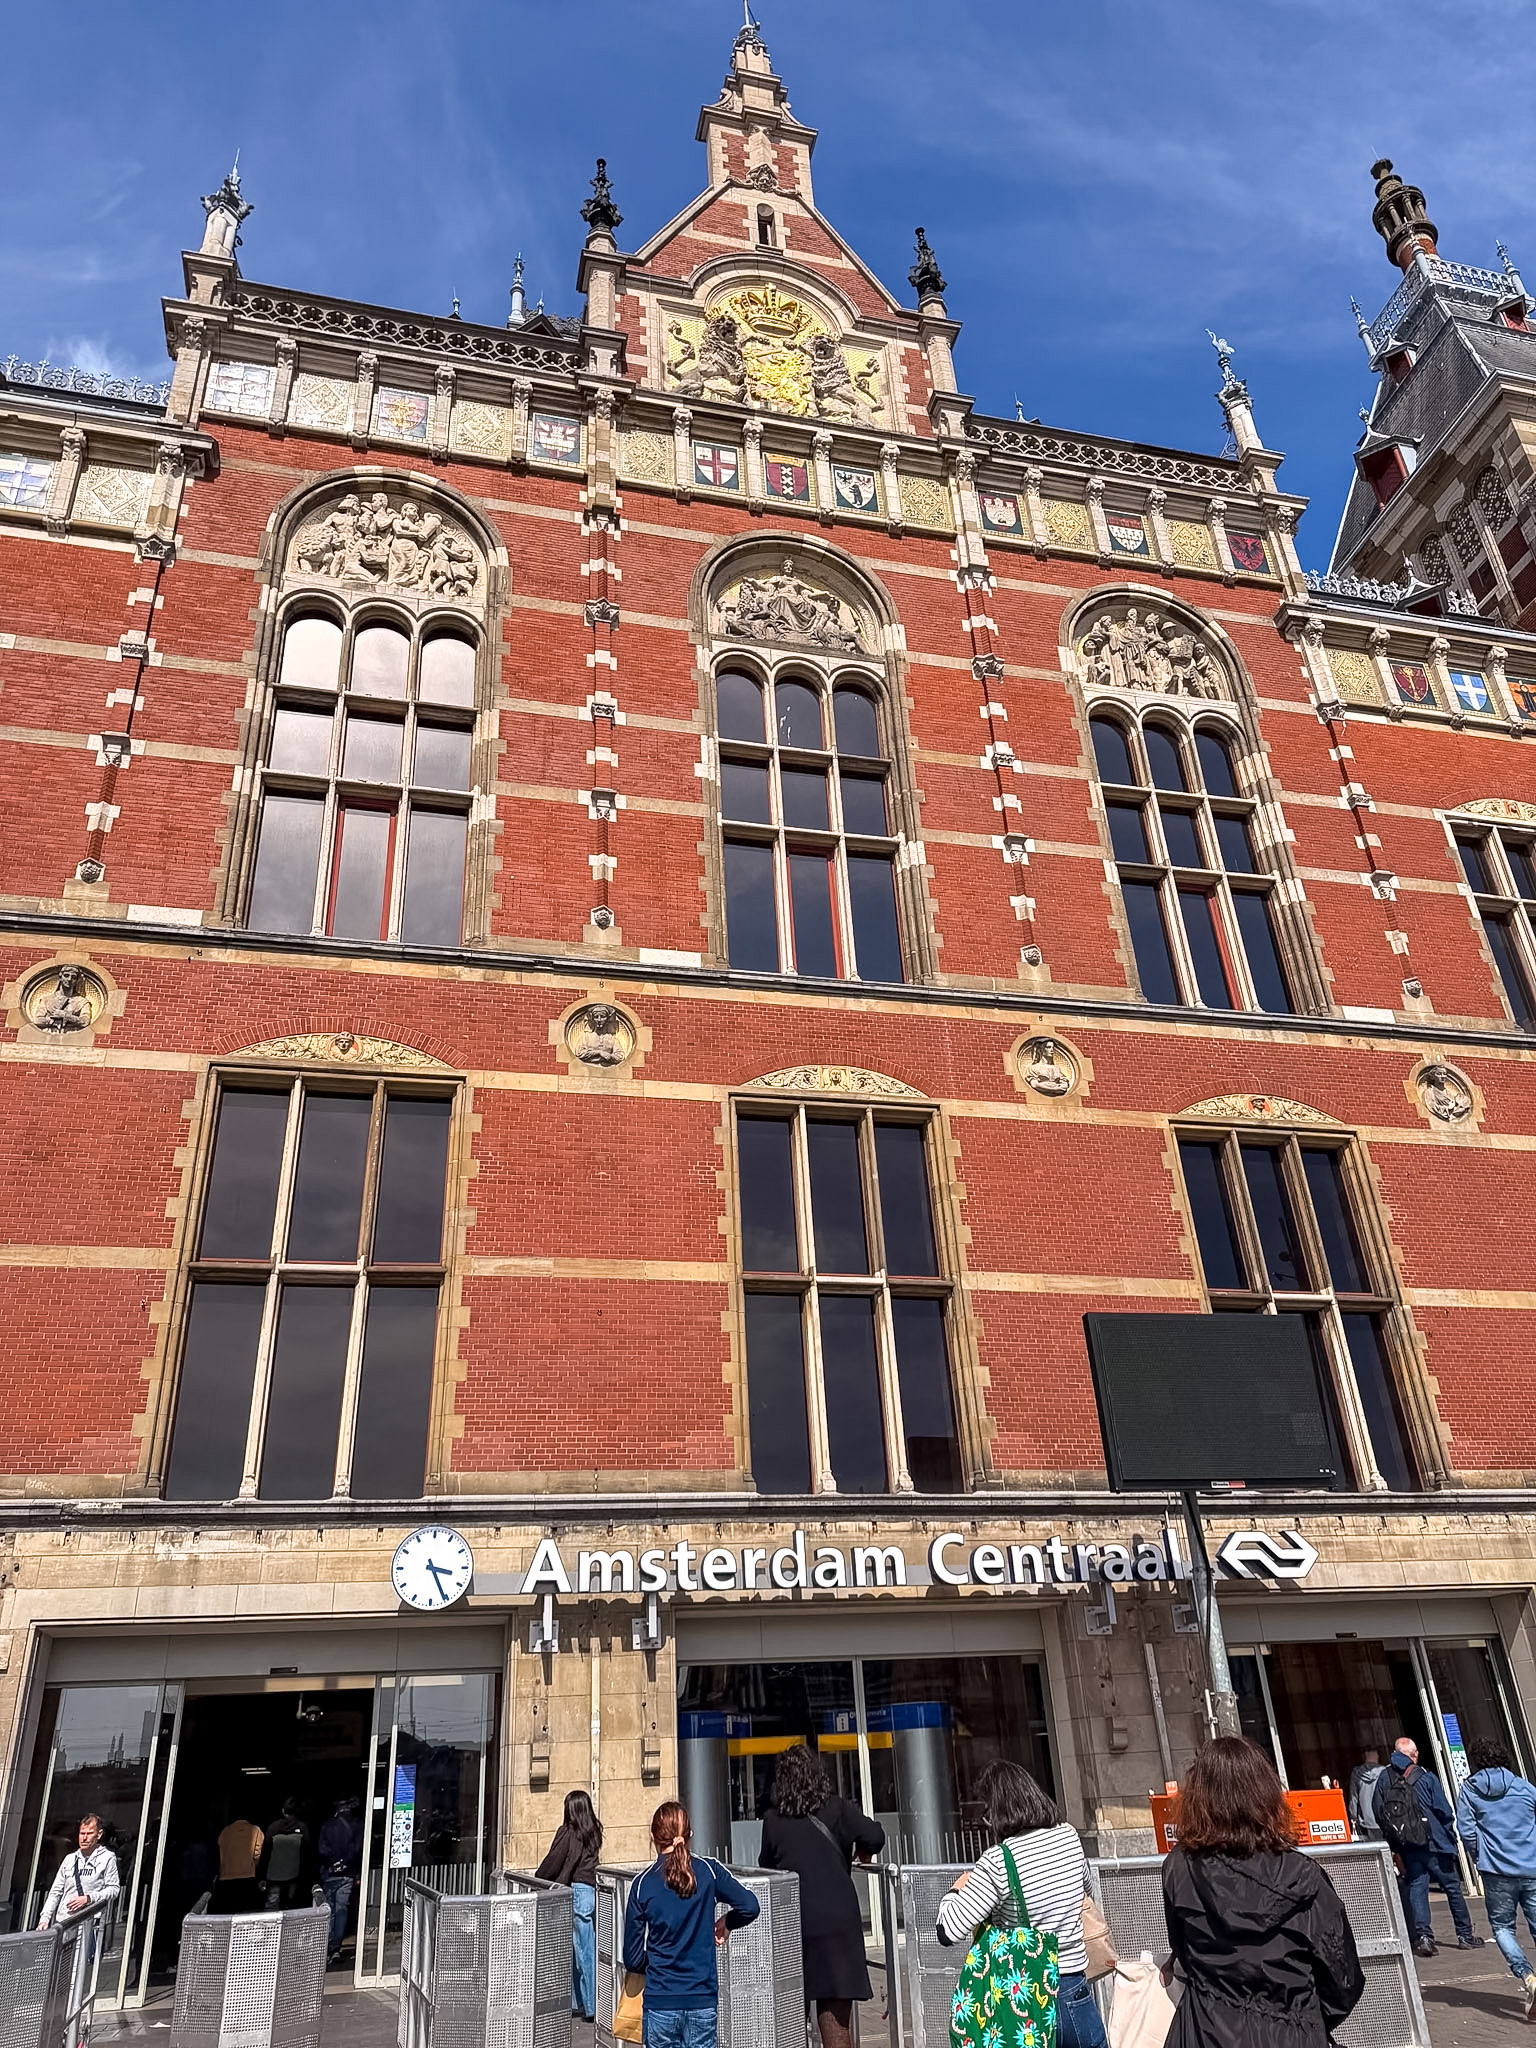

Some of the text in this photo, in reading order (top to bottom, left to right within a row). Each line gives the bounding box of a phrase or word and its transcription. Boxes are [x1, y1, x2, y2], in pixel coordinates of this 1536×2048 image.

[520, 1528, 1184, 1594] Amsterdam Centraal
[1311, 1822, 1344, 1833] Boels
